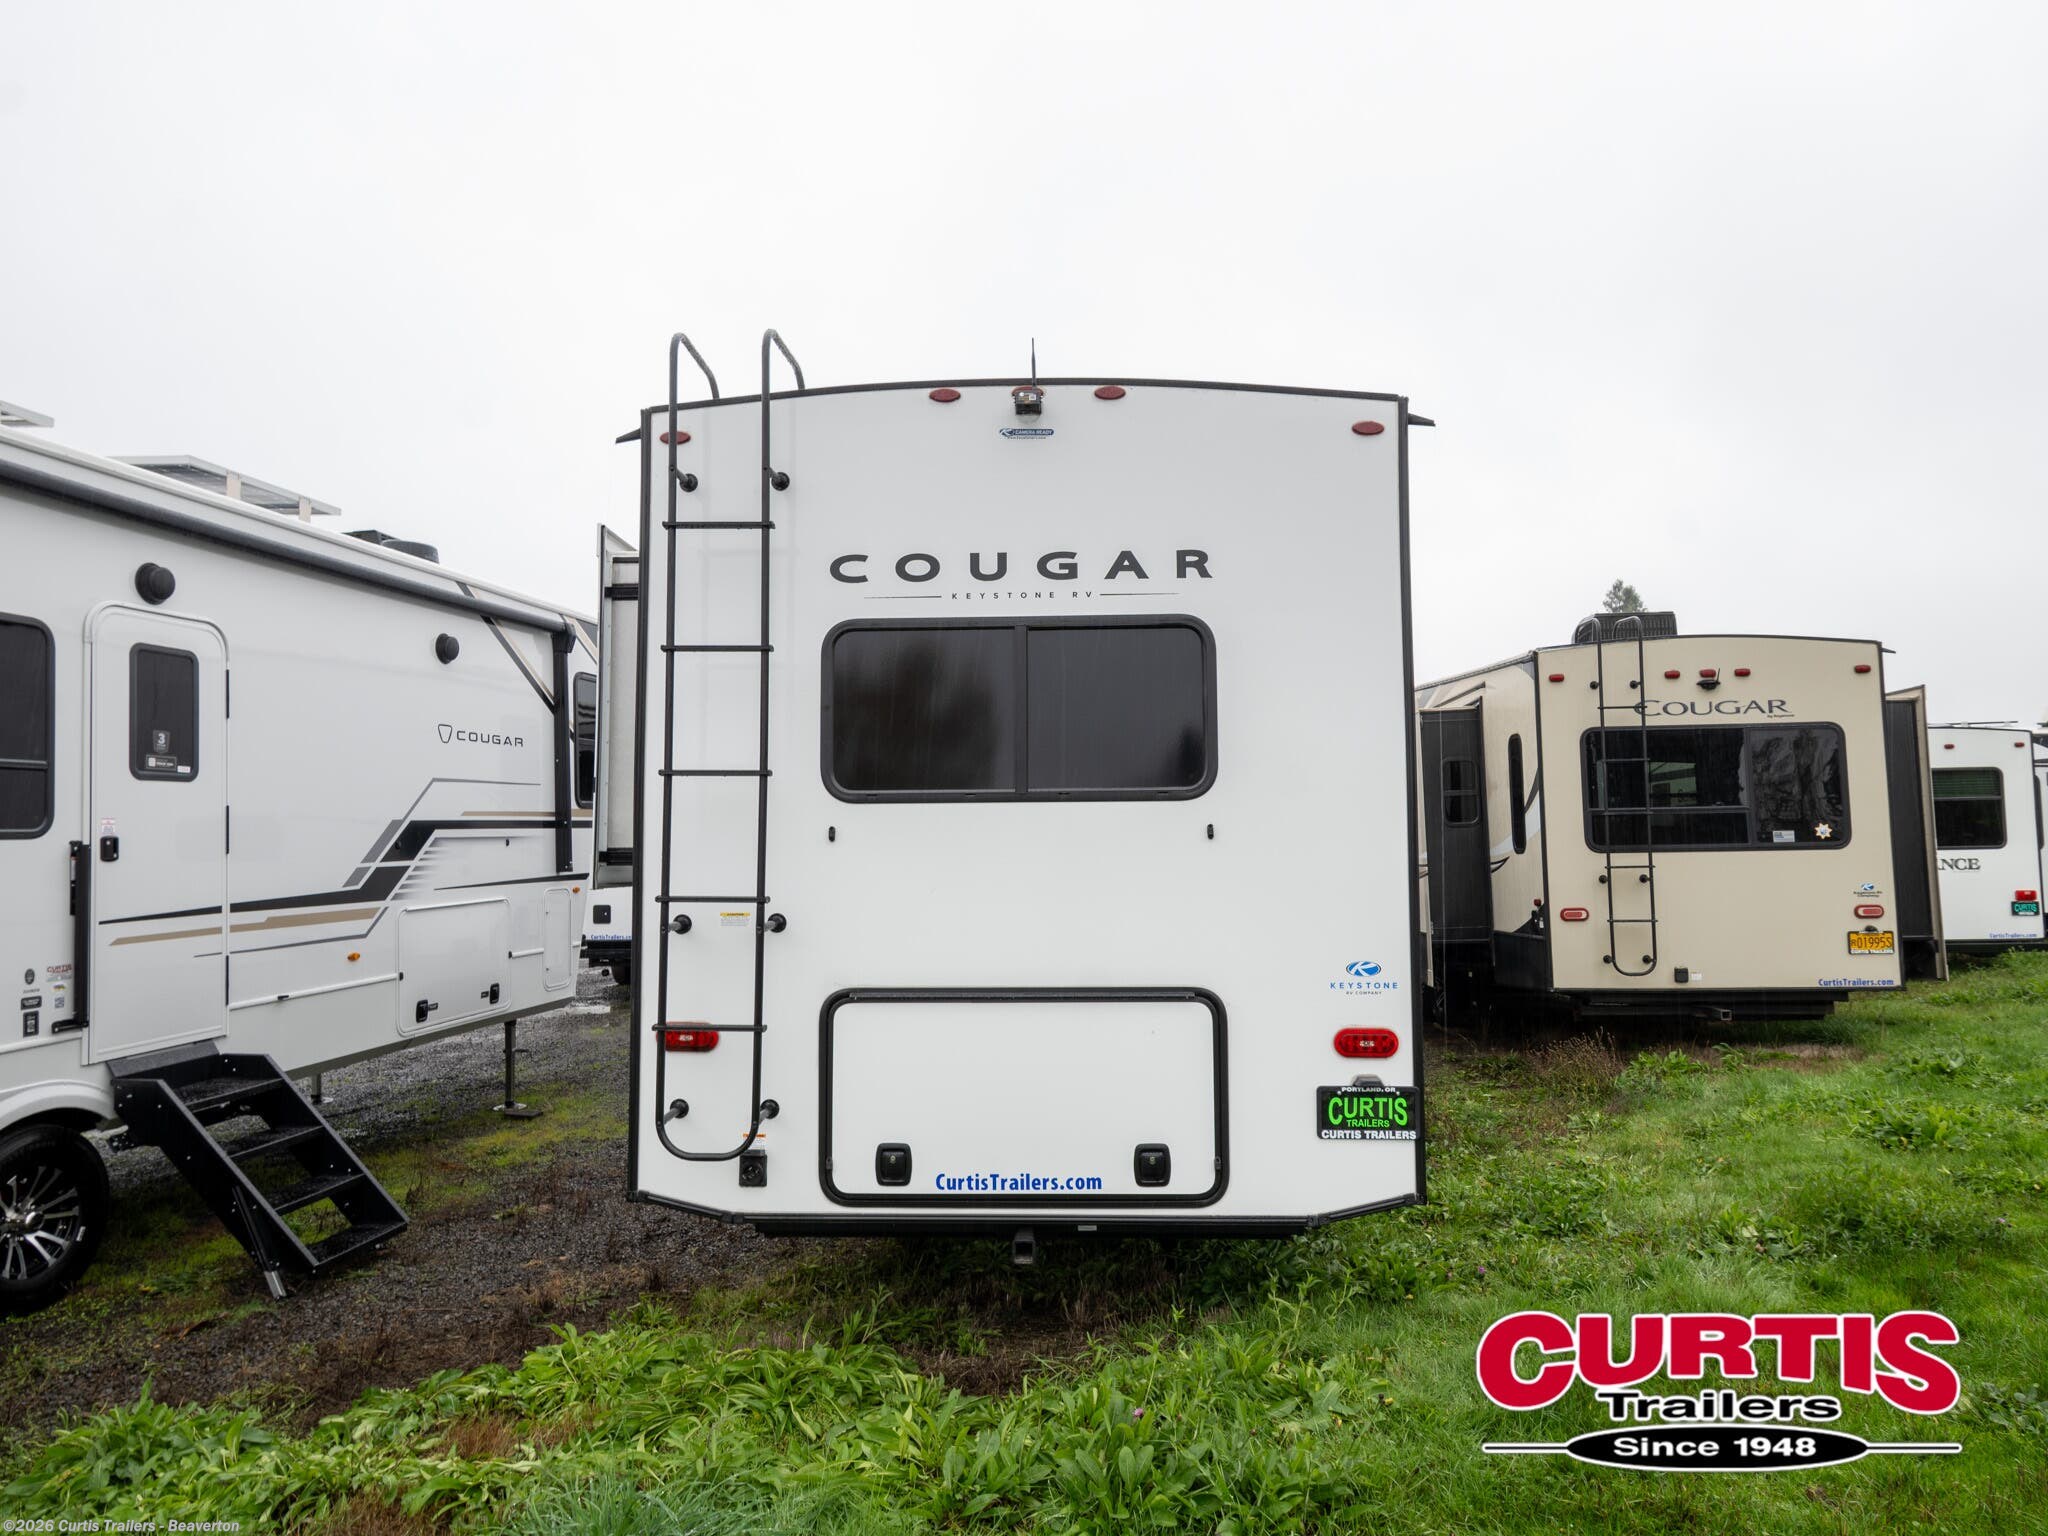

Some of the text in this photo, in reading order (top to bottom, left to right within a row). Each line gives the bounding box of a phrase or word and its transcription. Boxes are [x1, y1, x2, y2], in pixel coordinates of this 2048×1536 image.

[829, 549, 1213, 584] COUGAR
[951, 591, 1092, 600] KEYSTONE RV
[1634, 699, 1790, 716] COUGAR
[456, 730, 524, 747] COUGAR
[1938, 858, 1981, 870] NCE
[1818, 978, 1895, 987] CurtisTrailers.com
[1328, 1097, 1408, 1126] CURTIS
[1346, 1119, 1390, 1128] TRAILERS
[1321, 1130, 1417, 1139] CURTIS TRAILERS
[935, 1173, 1103, 1191] CurtisTrailers.com
